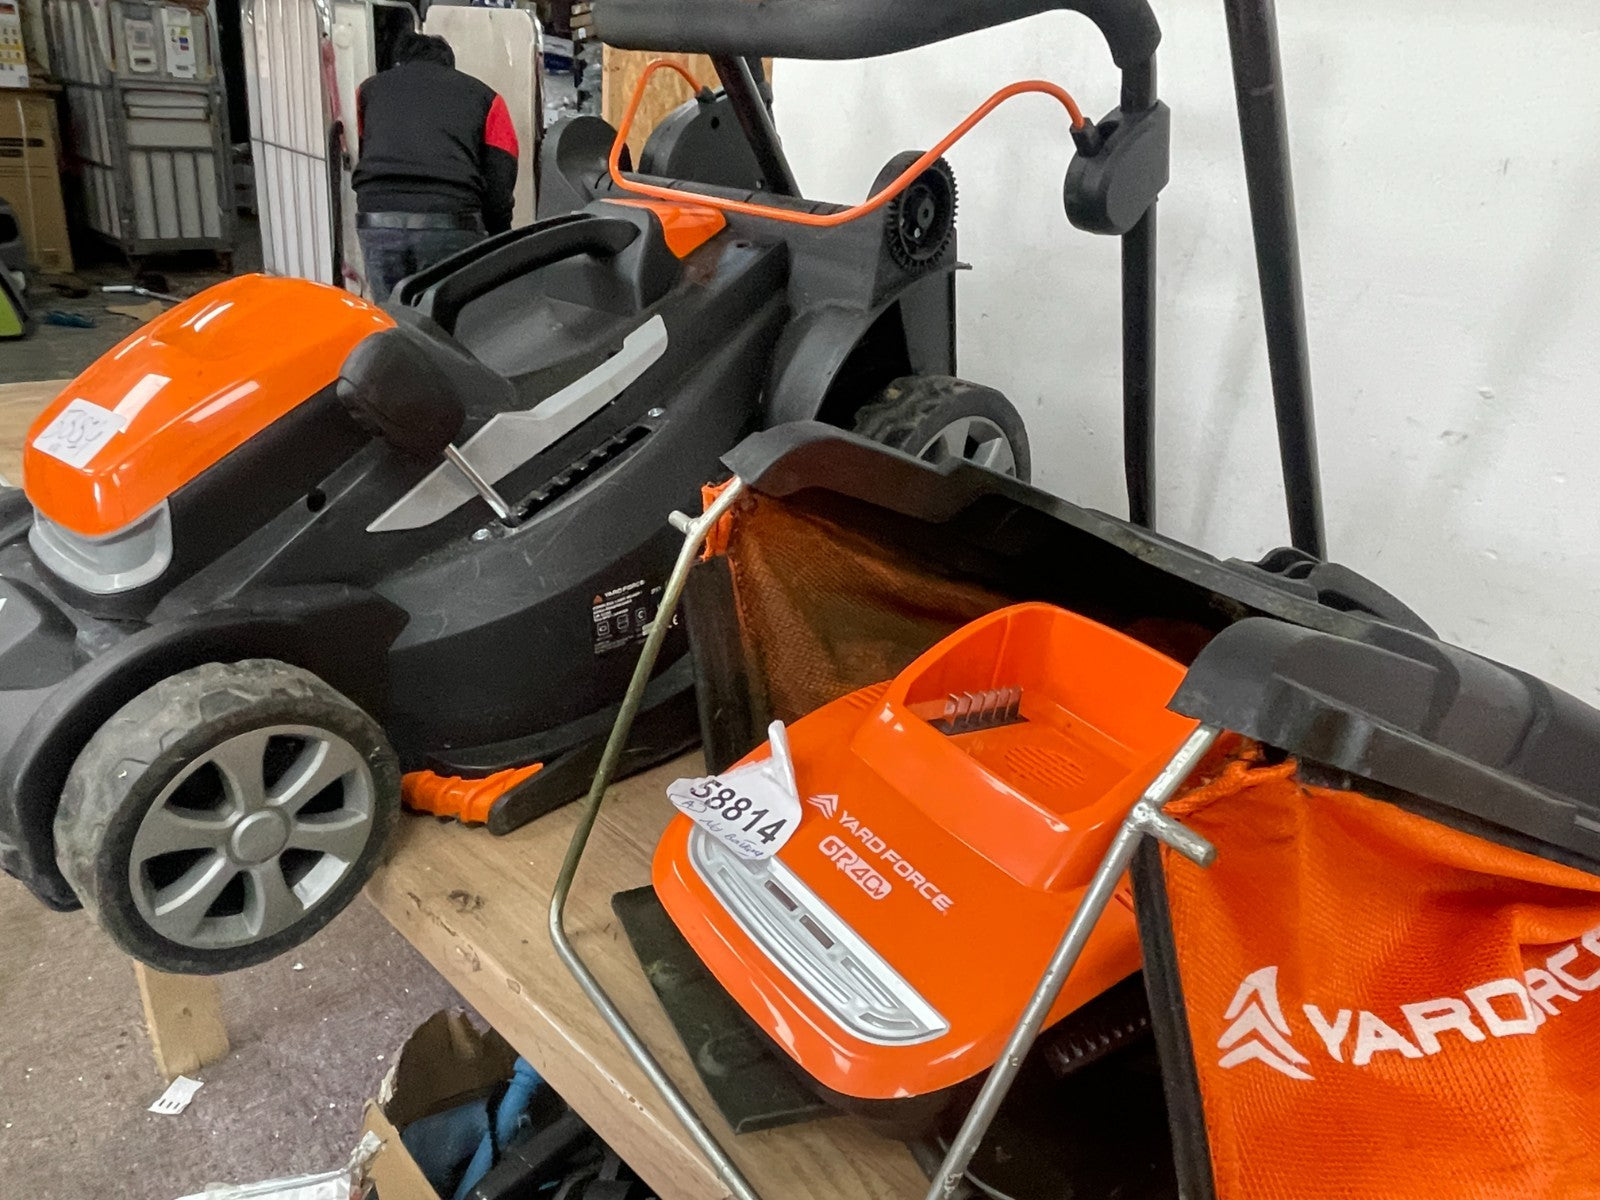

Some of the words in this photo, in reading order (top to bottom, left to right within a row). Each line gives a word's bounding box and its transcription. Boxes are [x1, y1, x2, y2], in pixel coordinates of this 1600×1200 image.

[690, 779, 787, 844] 58814
[838, 810, 886, 855] YARD
[880, 848, 954, 912] FORCE
